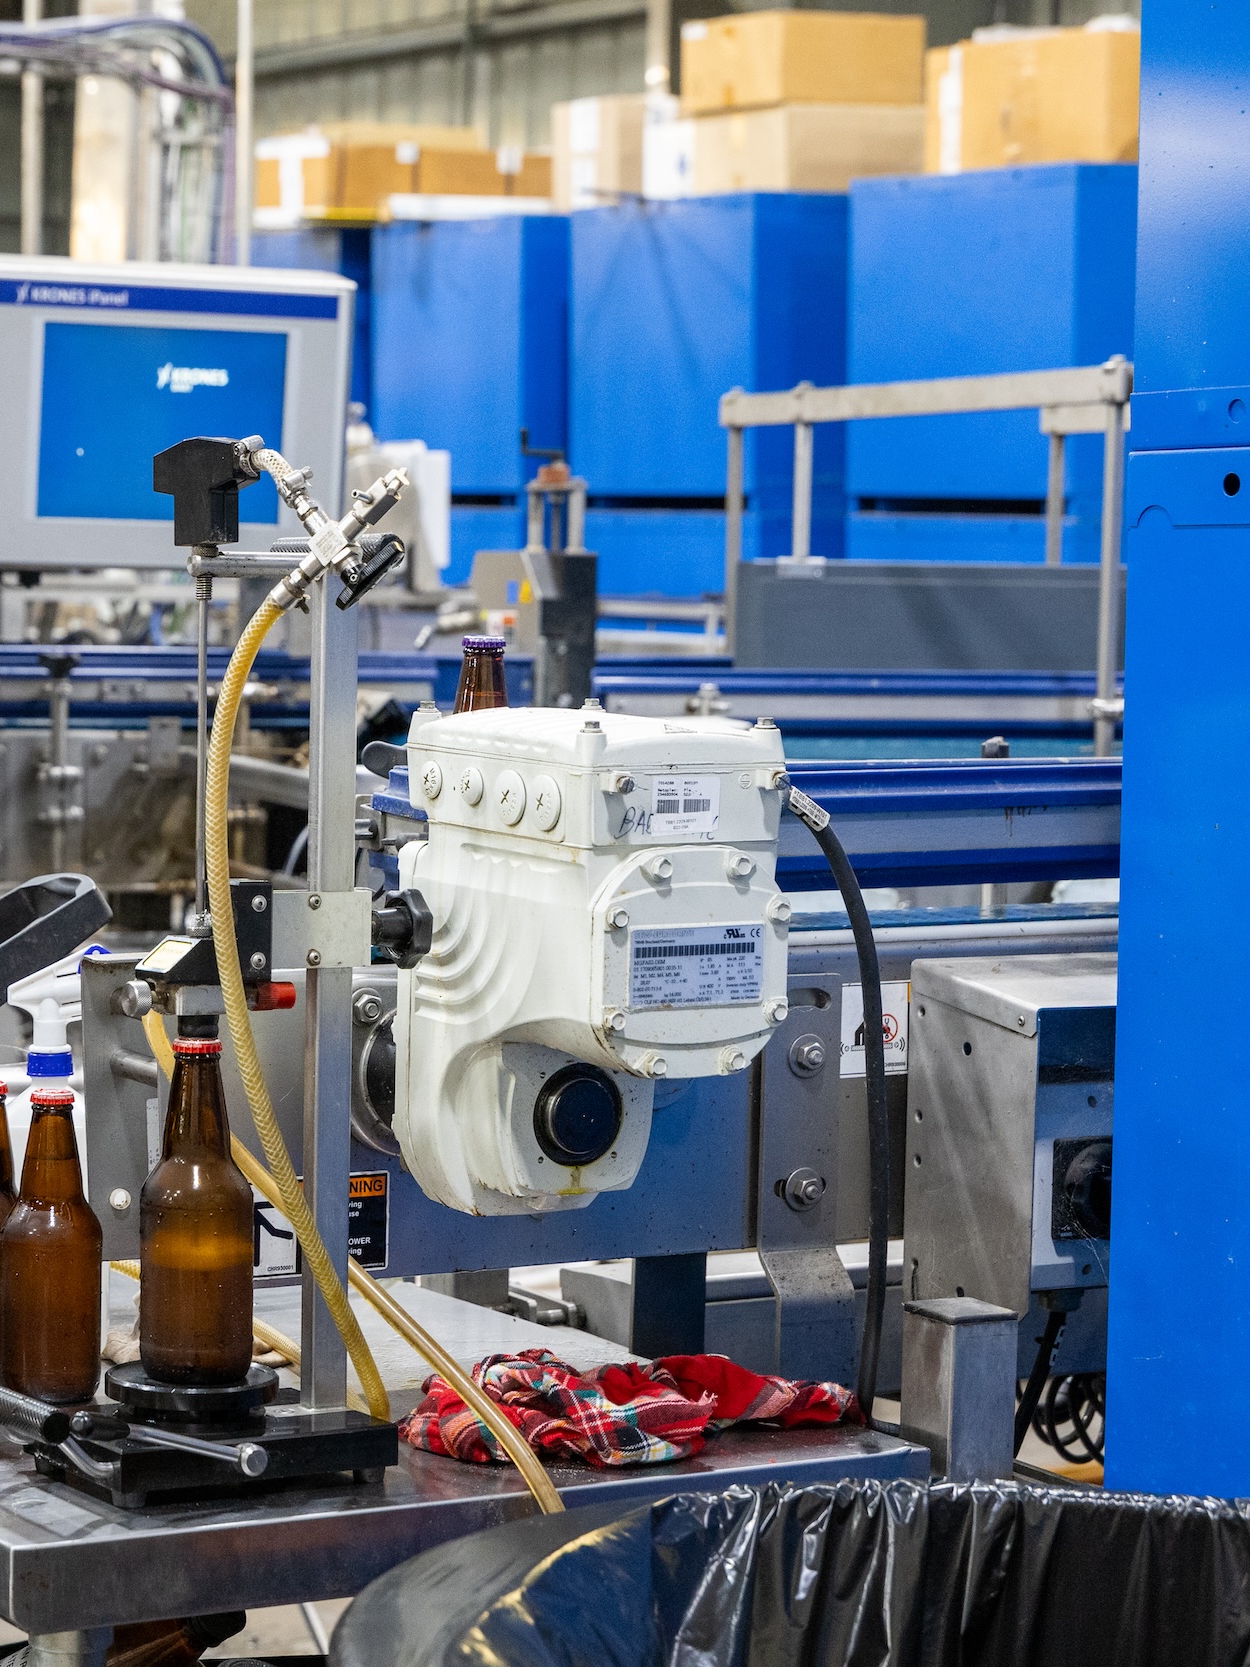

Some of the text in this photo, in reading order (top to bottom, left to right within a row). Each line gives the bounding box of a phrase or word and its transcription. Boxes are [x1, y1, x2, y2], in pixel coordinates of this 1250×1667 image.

[30, 286, 87, 305] KRONES
[349, 1179, 384, 1194] NING
[348, 1236, 372, 1246] OWER
